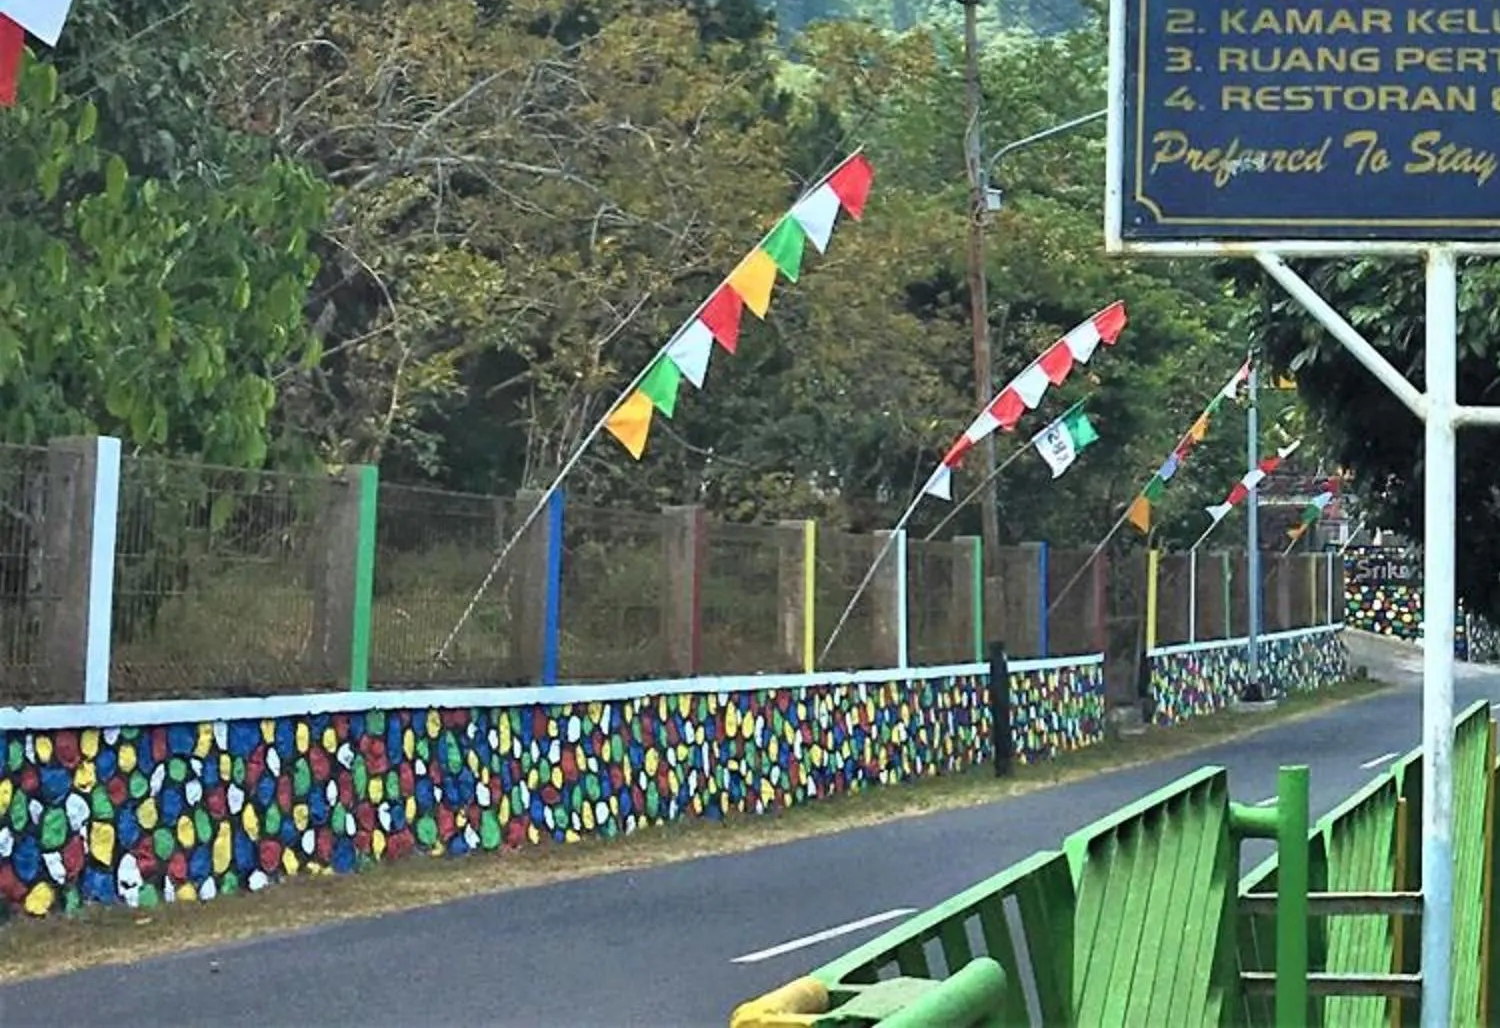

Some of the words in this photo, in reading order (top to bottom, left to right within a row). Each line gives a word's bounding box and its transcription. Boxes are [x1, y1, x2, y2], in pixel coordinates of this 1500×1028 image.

[1165, 8, 1206, 35] 2.
[1220, 8, 1393, 35] KAMAR
[1164, 46, 1203, 73] 3.
[1218, 46, 1381, 73] RUANG
[1163, 85, 1206, 112] 4.
[1221, 84, 1477, 112] RESTORAN
[1343, 129, 1392, 176] To
[1404, 129, 1499, 187] Stay
